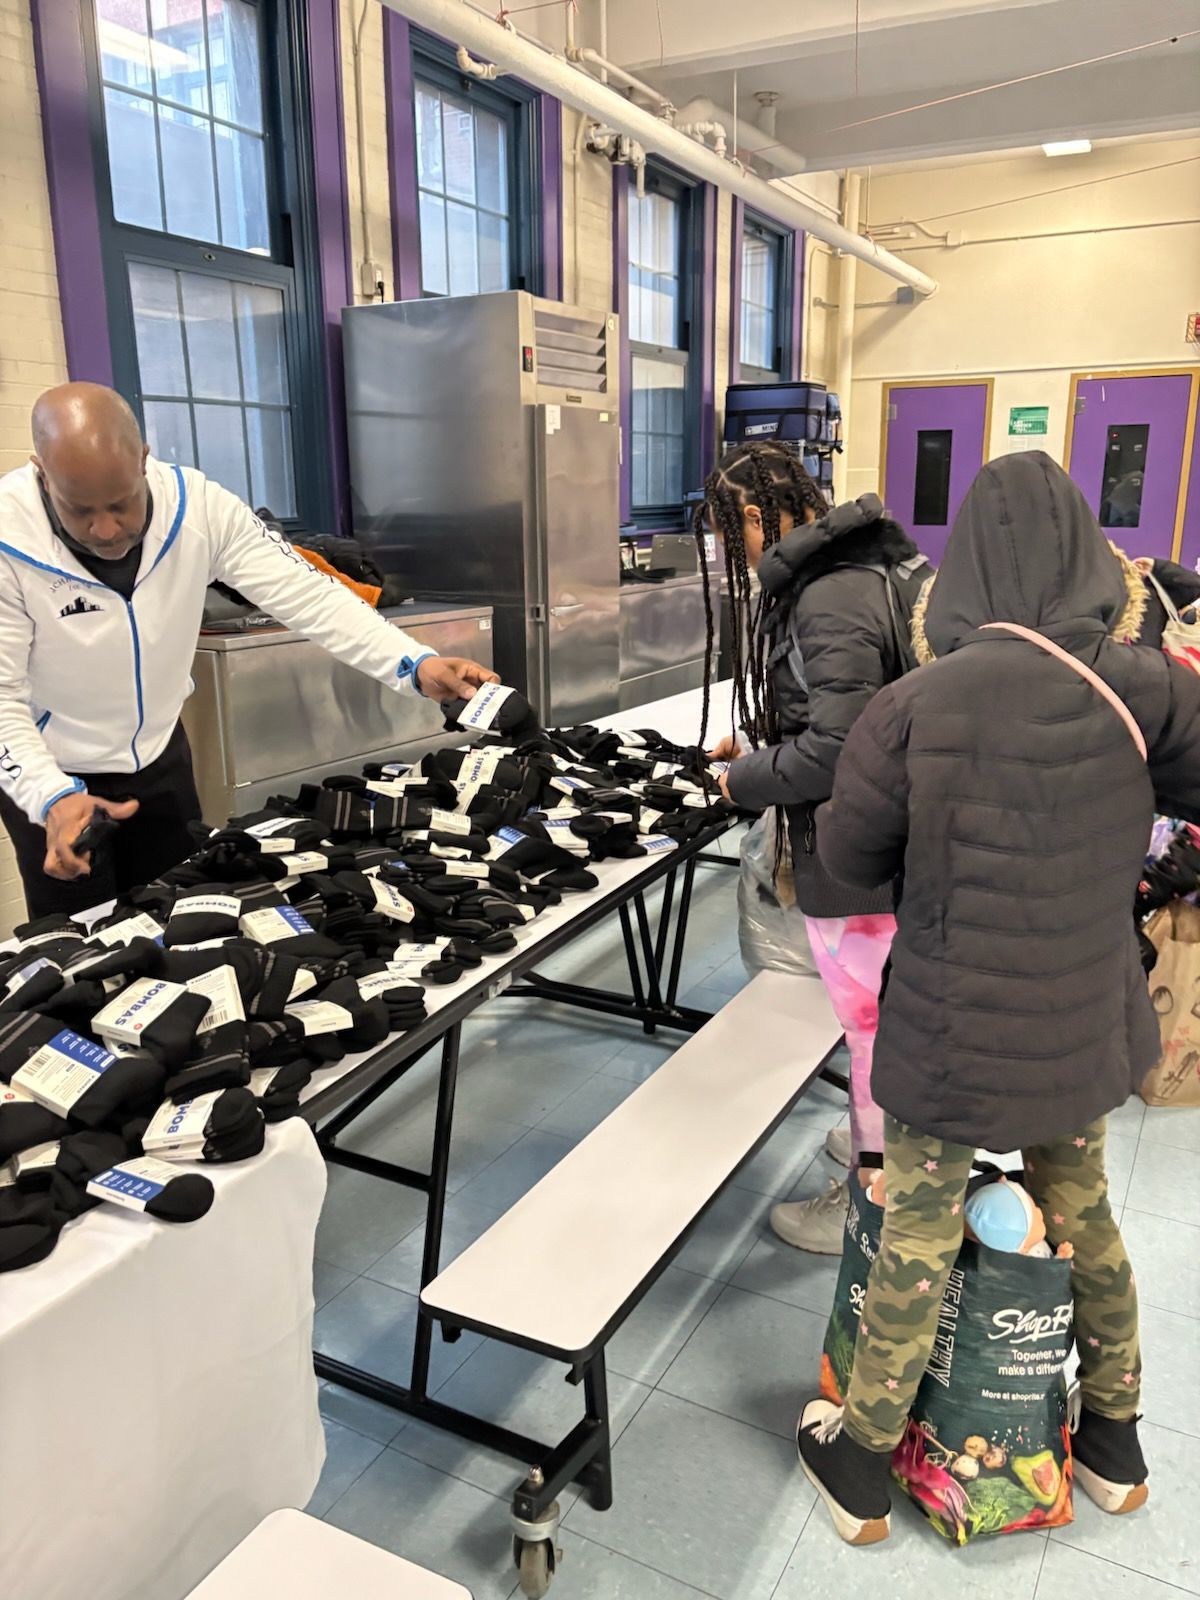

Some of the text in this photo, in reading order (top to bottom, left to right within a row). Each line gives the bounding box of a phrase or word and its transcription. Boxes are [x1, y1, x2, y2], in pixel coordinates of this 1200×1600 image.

[470, 686, 500, 724] BOMBAS
[471, 757, 485, 783] OMBAS
[115, 982, 168, 1026] BOMBAS
[849, 1283, 866, 1312] Sh
[998, 1364, 1026, 1376] make
[1027, 1367, 1034, 1375] a
[981, 1389, 1001, 1399] More
[1002, 1391, 1010, 1400] at
